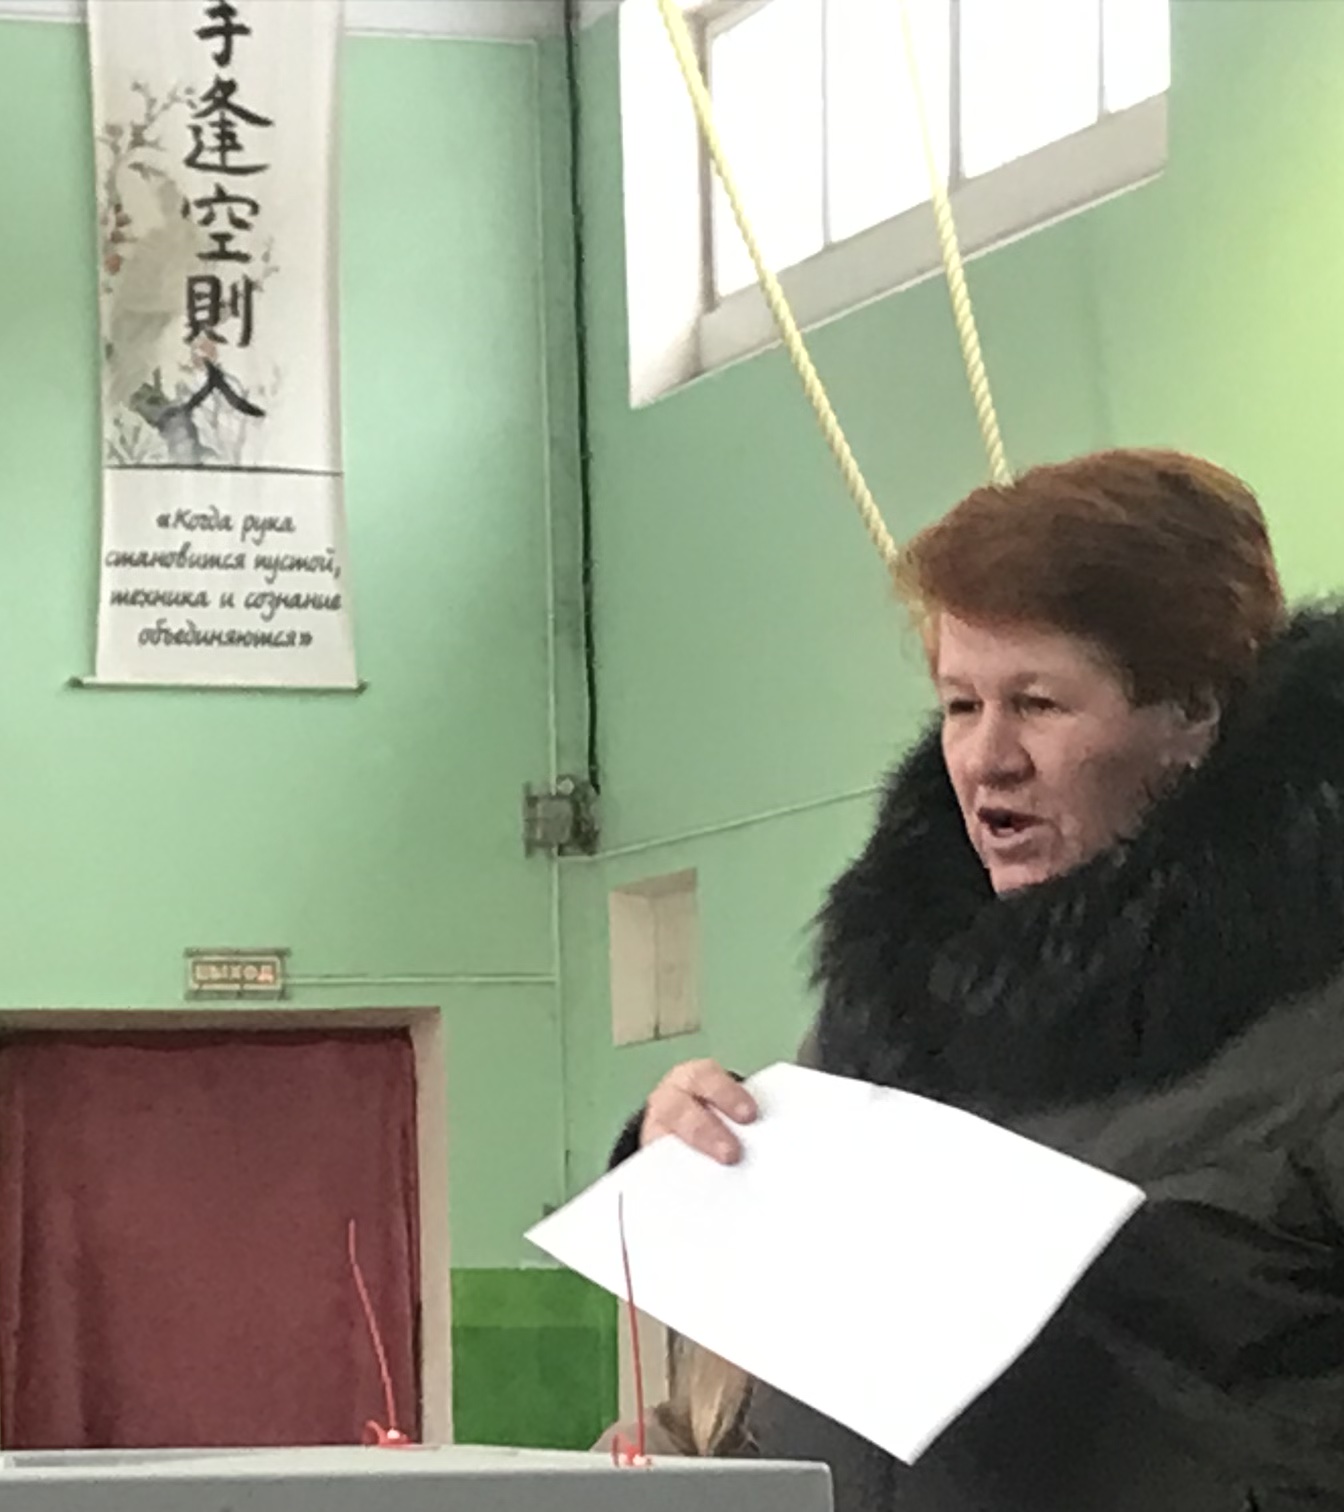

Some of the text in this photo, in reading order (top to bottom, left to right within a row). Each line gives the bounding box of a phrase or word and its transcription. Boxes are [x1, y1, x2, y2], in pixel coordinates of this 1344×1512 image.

[241, 513, 296, 546] рука
[105, 541, 246, 571] становится
[110, 588, 343, 622] техника и сознание
